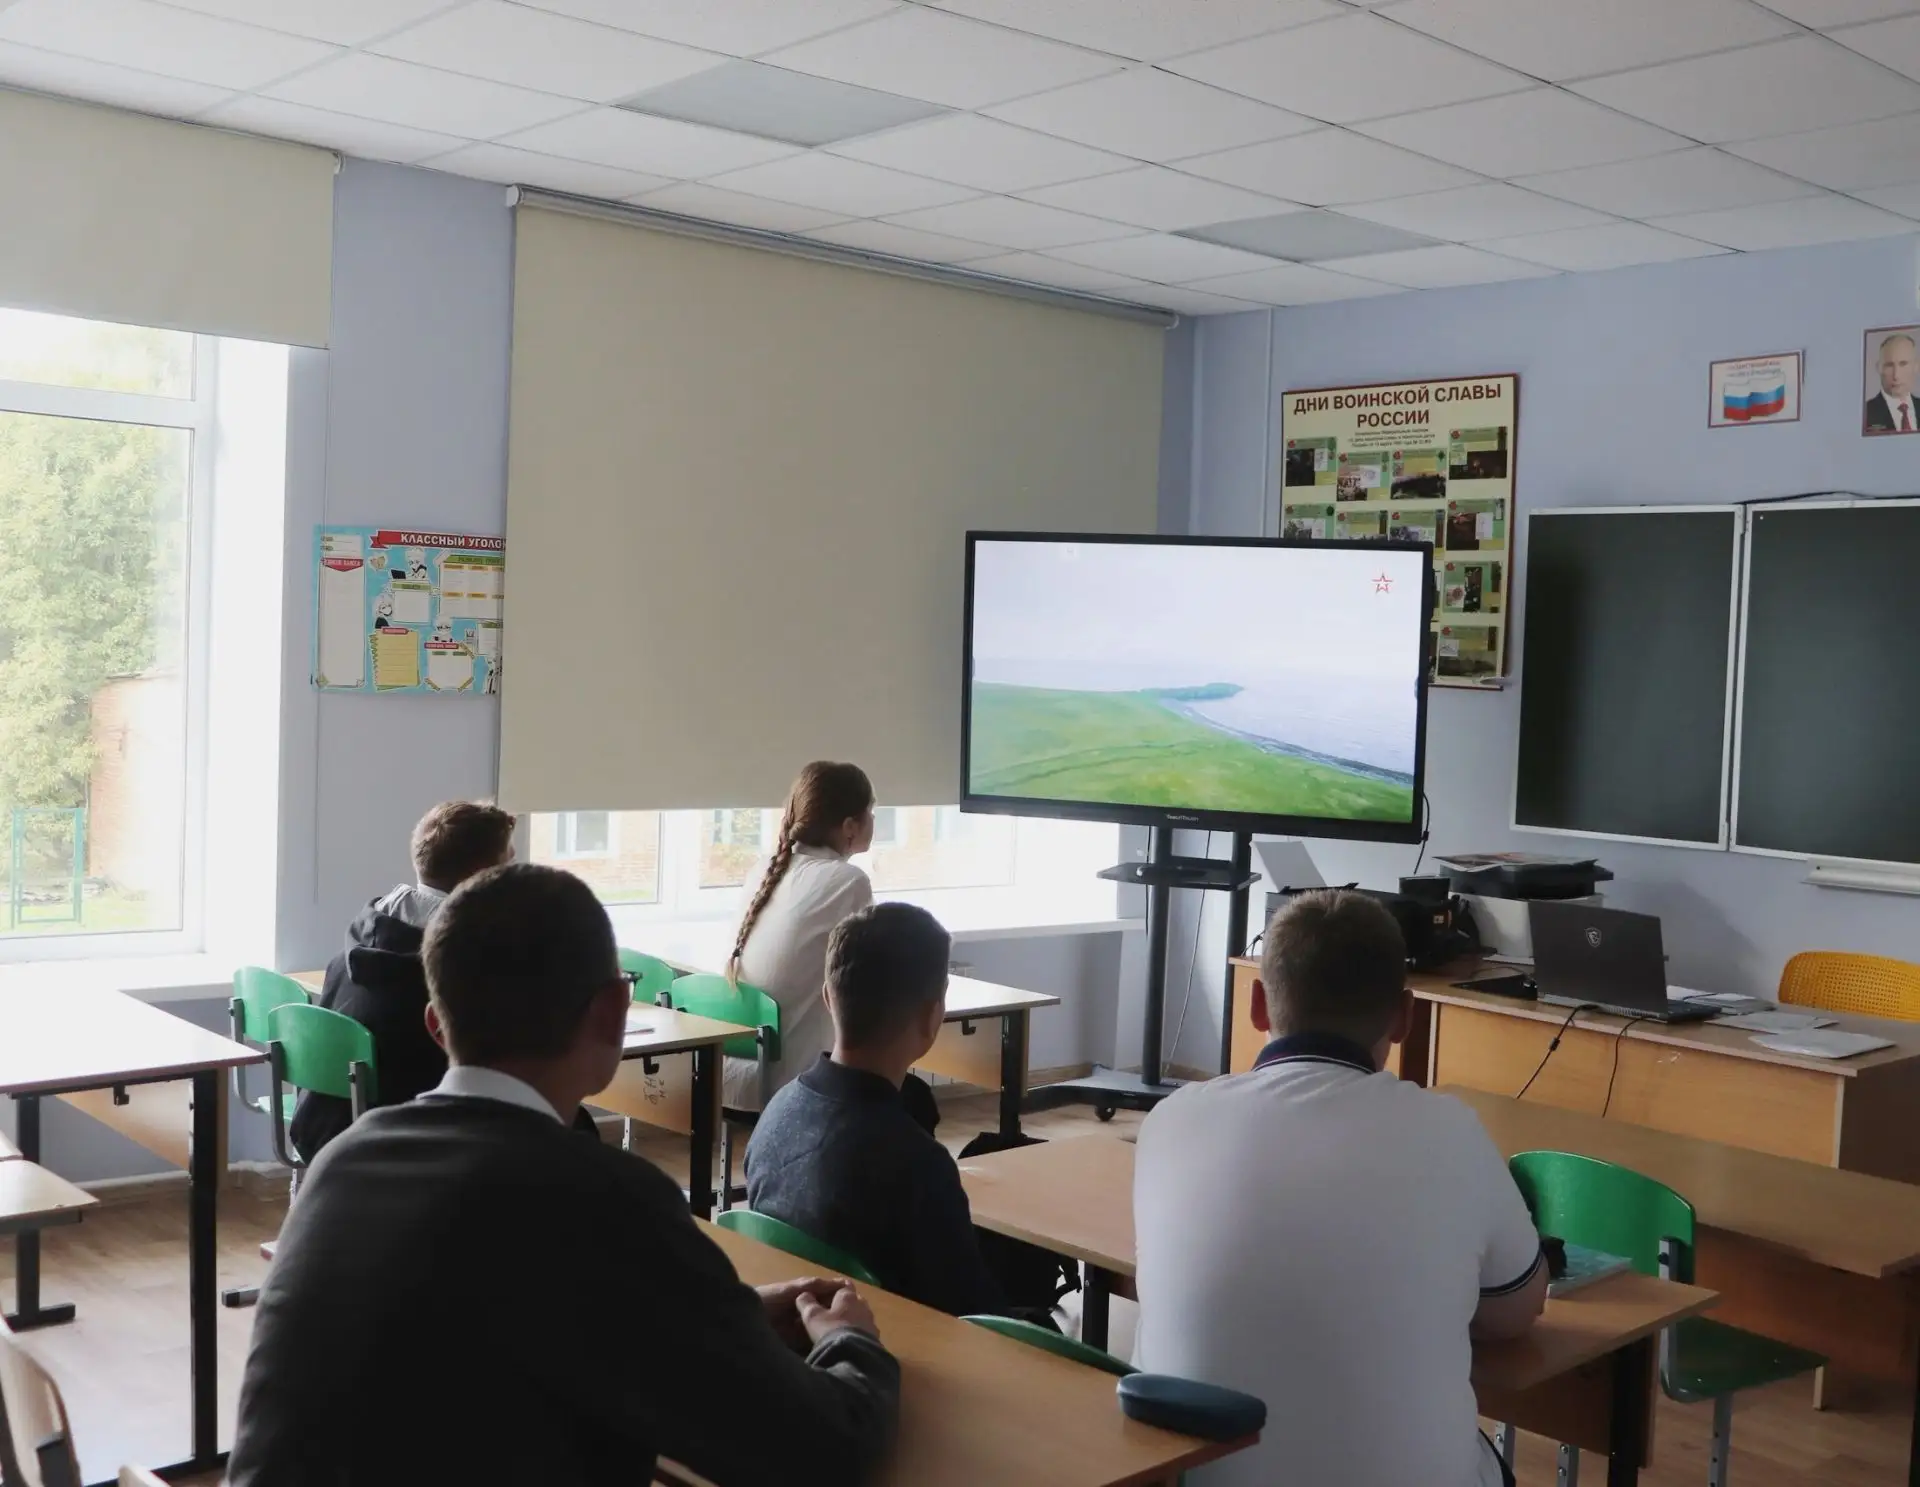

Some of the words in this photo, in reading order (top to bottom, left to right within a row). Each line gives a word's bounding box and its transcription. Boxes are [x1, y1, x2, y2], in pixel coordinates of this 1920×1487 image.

[1293, 397, 1329, 415] ДНИ
[1333, 387, 1430, 409] ВОИНСКОЙ
[1434, 383, 1501, 402] СЛАВЫ
[1357, 410, 1430, 428] РОССИИ
[401, 533, 466, 547] КЛАССНЫЙ
[468, 538, 505, 549] УГОЛО
